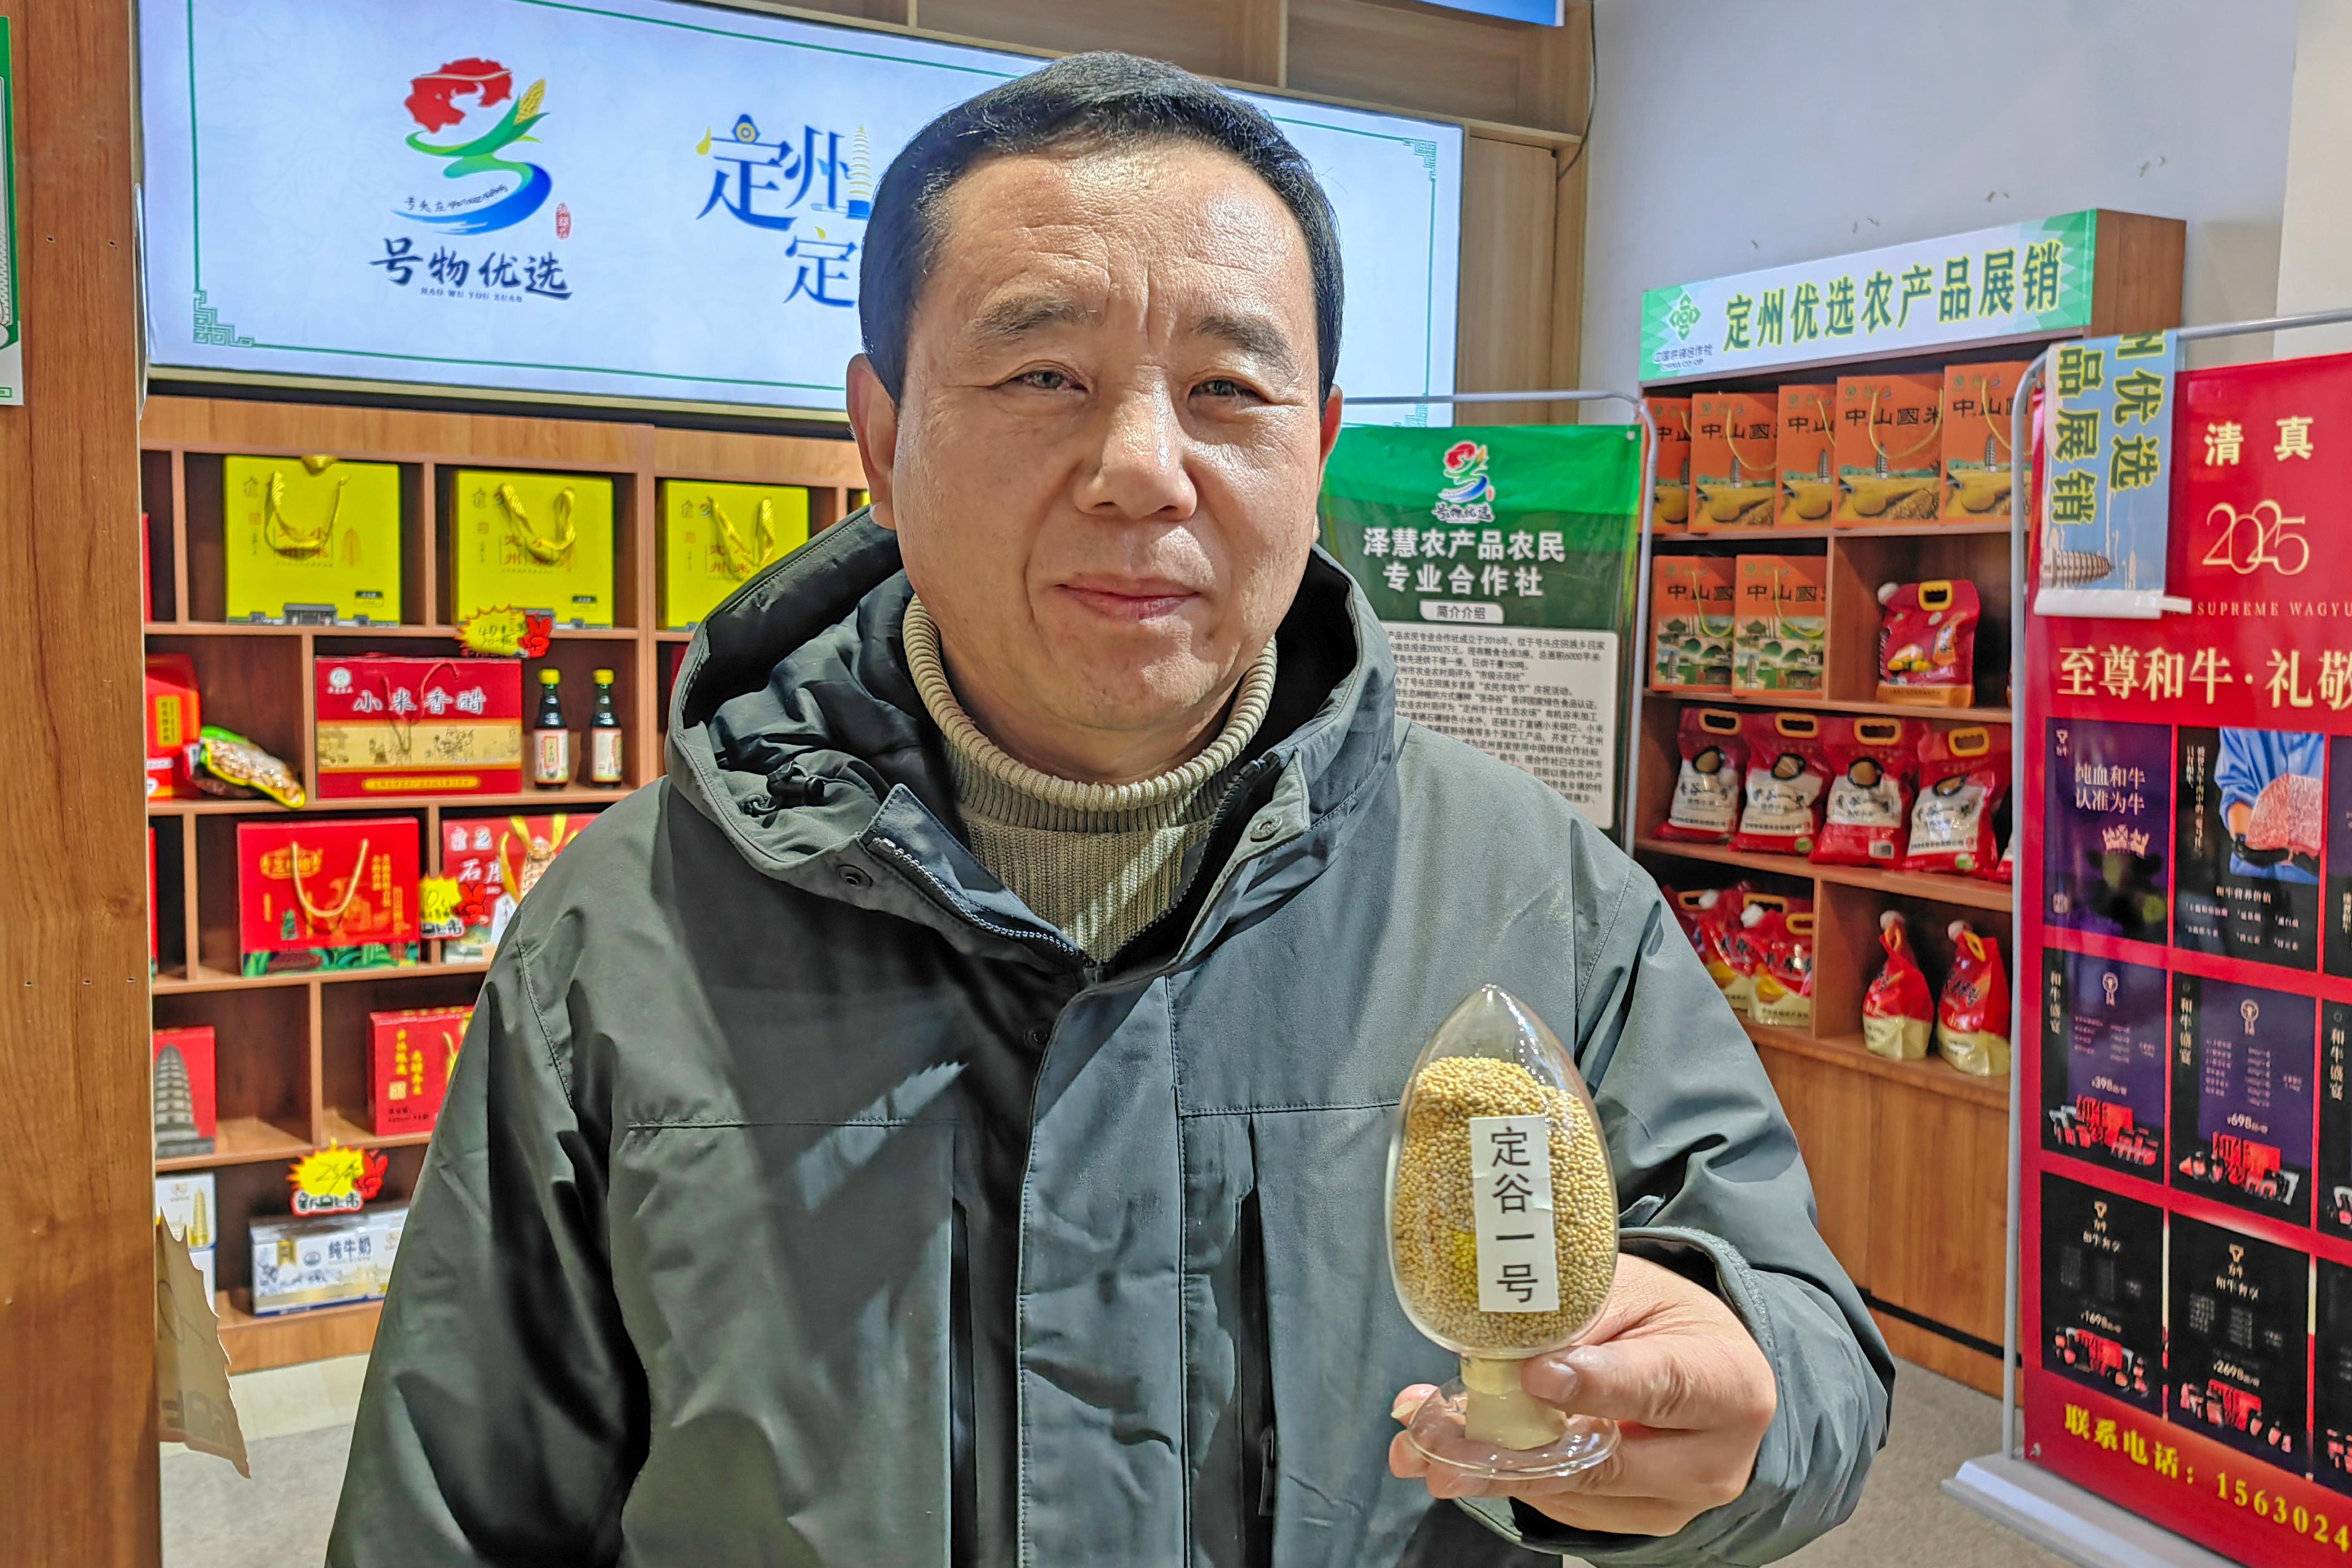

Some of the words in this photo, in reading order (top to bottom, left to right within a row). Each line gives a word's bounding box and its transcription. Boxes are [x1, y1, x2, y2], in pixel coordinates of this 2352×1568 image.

[368, 237, 573, 301] 号物优选
[1723, 239, 2064, 351] 定州优选农产品展销
[2051, 345, 2105, 524] 品展销
[2204, 416, 2314, 466] 清真
[1363, 527, 1566, 562] 泽慧农产品农民
[2202, 500, 2310, 575] 2025
[1382, 562, 1544, 597] 专业合作社
[1436, 604, 1487, 620] 简介介绍
[2197, 600, 2280, 617] SUPREME
[353, 687, 488, 715] 小米香醋
[1491, 1126, 1539, 1304] 定谷一号
[328, 1236, 372, 1260] 纯牛奶
[2216, 1471, 2349, 1553] 1563024
